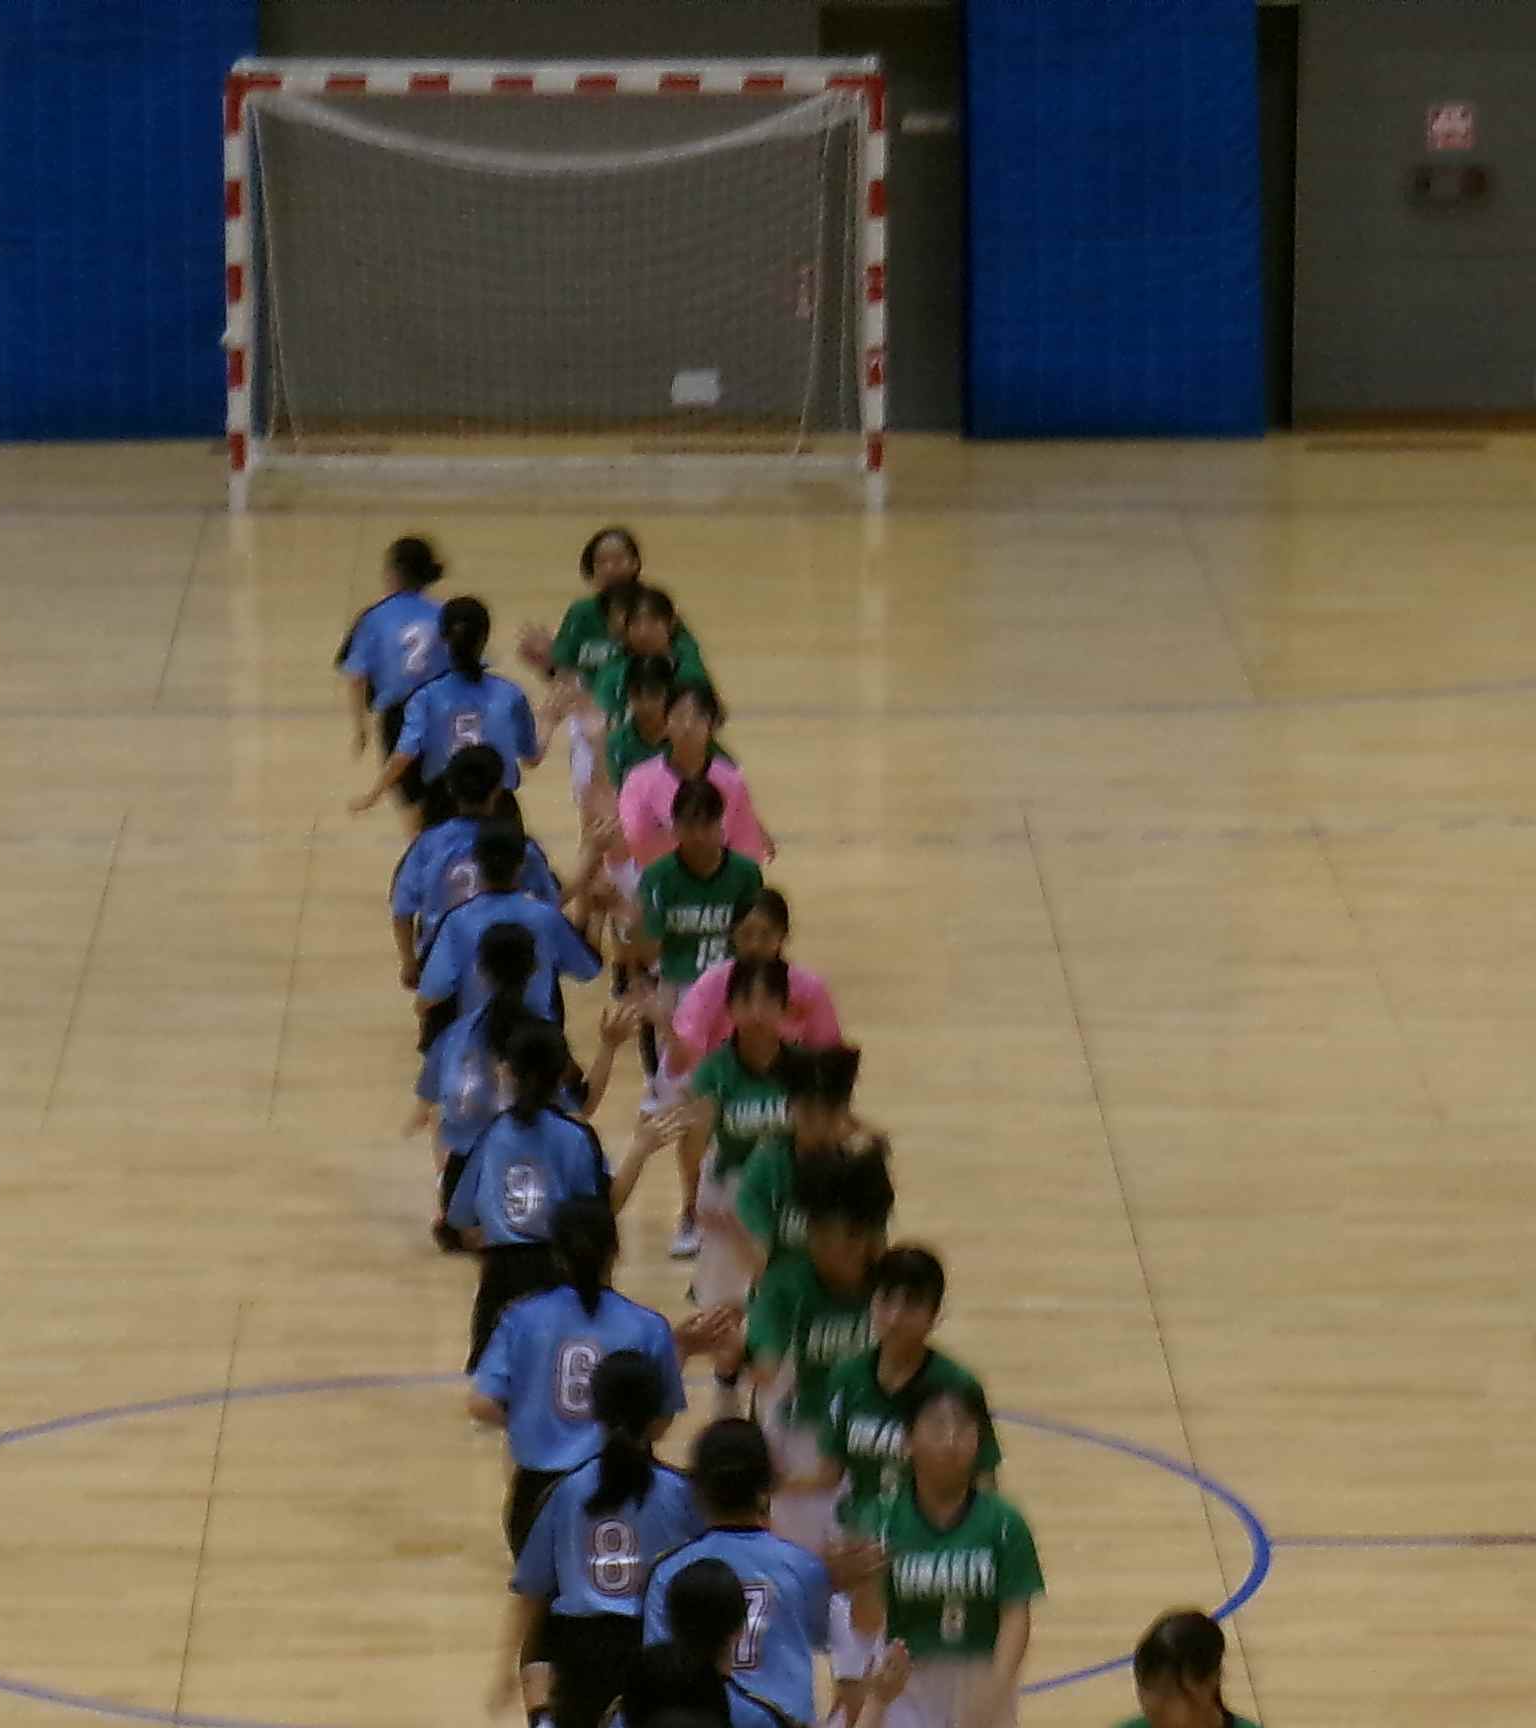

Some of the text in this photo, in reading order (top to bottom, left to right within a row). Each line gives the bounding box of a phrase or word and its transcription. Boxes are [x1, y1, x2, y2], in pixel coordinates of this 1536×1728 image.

[555, 1342, 600, 1420] 6
[589, 1517, 637, 1597] 8
[731, 1580, 770, 1670] 7
